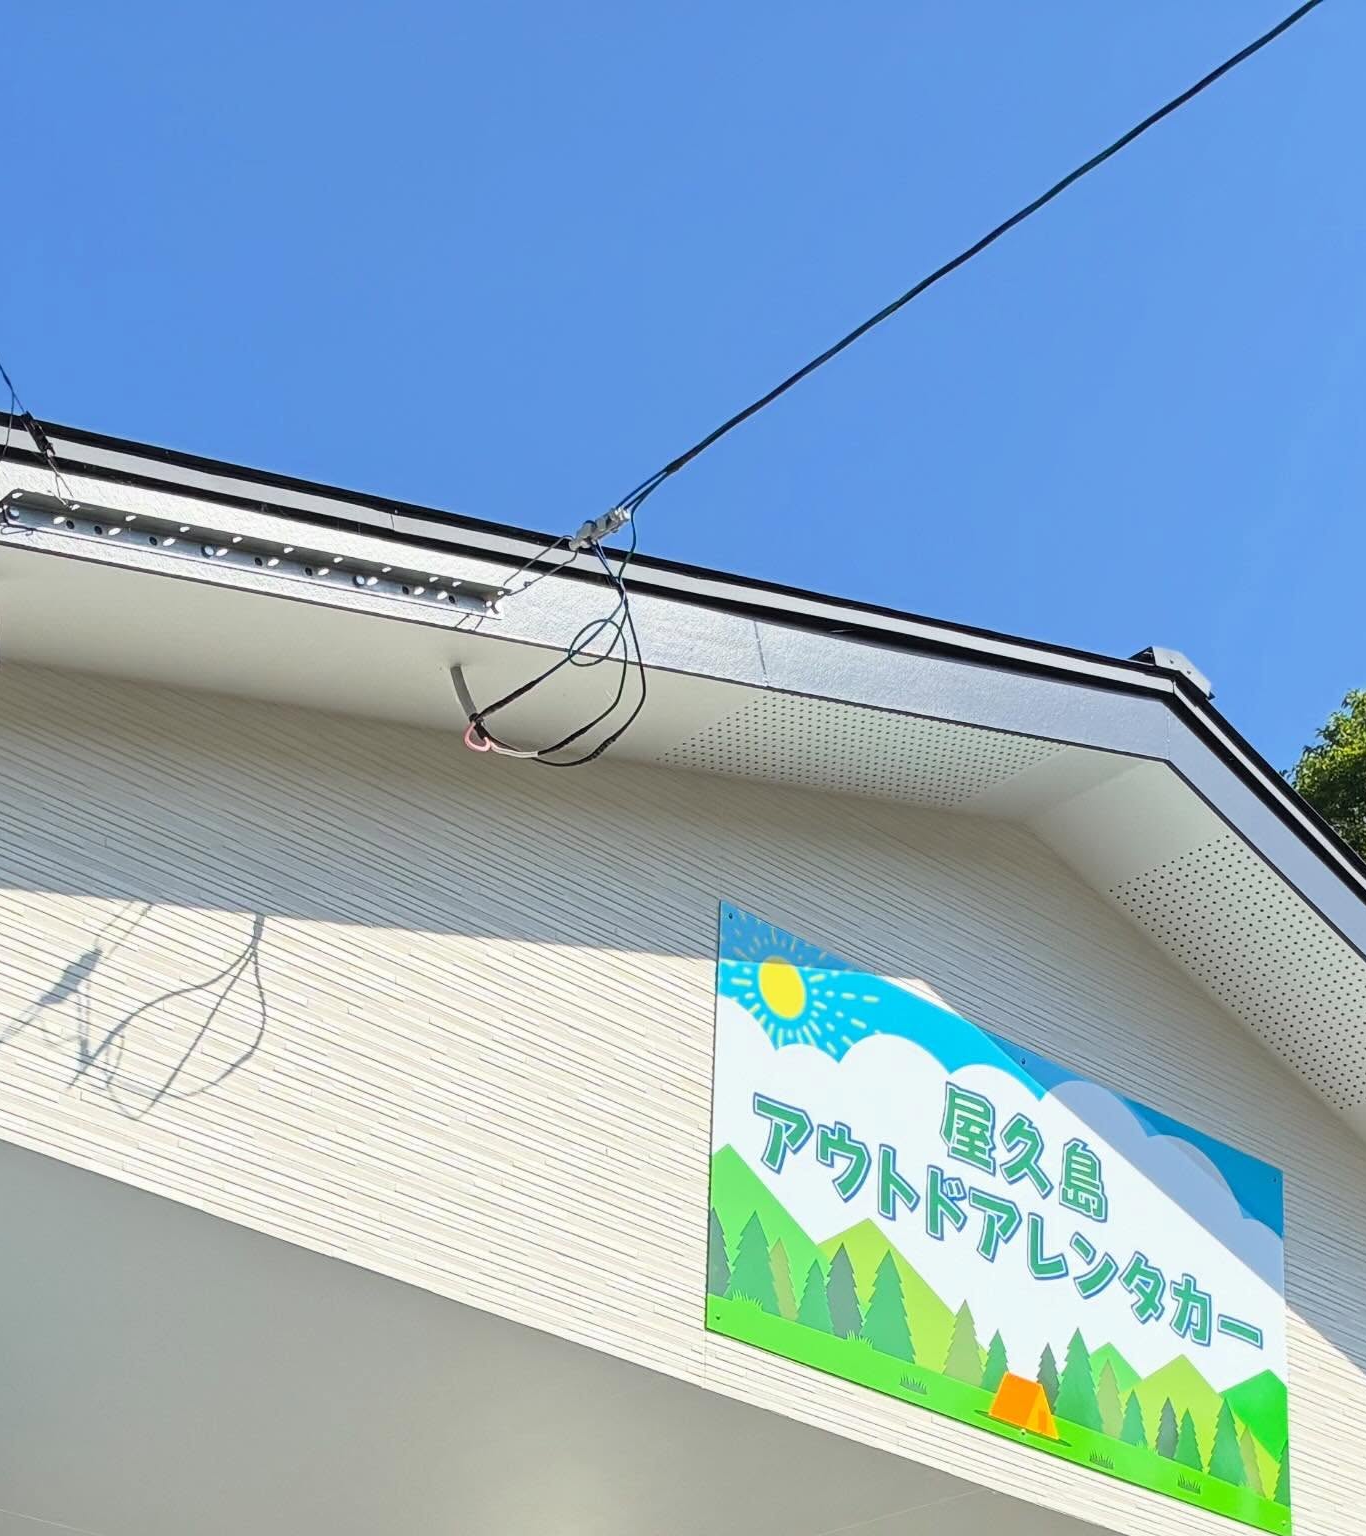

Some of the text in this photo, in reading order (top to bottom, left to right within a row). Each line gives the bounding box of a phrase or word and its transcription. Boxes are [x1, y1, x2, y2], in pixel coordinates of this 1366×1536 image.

[753, 1093, 1265, 1350] アウトドアレンタカー
[940, 1082, 1108, 1221] 屋久島
